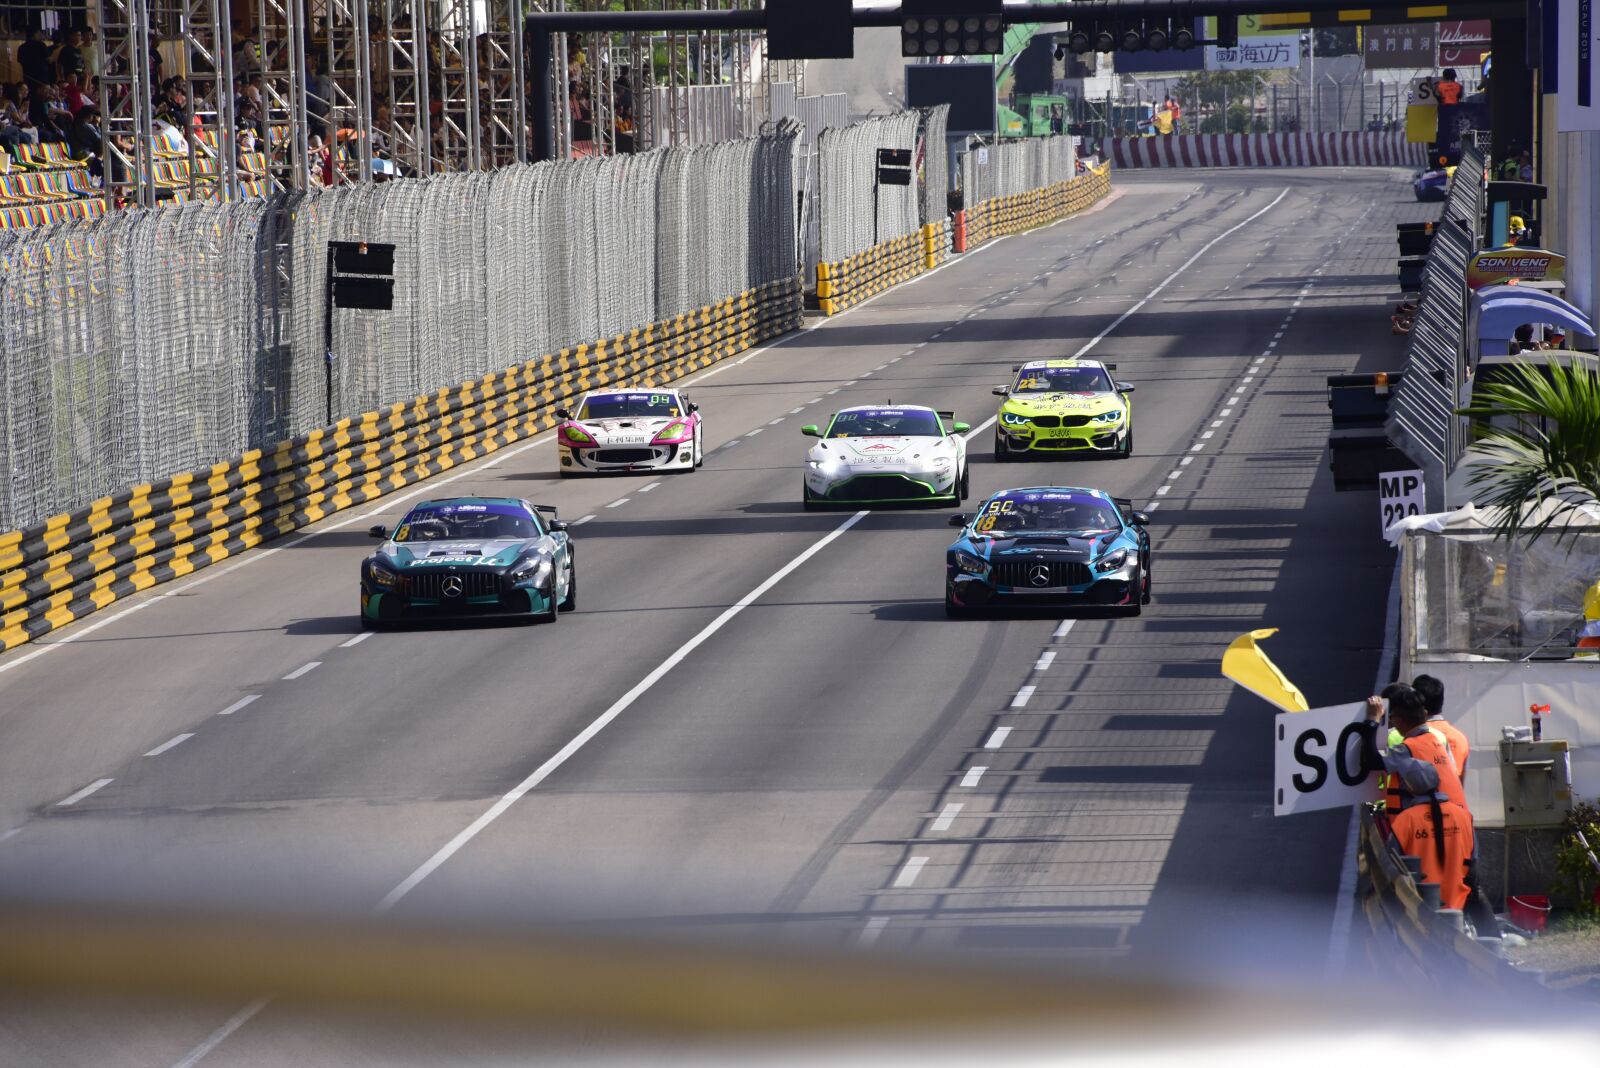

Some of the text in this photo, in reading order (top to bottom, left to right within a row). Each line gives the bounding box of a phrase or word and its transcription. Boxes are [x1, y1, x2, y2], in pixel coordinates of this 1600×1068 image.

[1477, 258, 1549, 267] SON VENG
[1380, 475, 1419, 498] MP
[976, 515, 997, 531] 18
[396, 525, 411, 541] 8
[410, 556, 472, 567] project
[1415, 828, 1428, 839] 66
